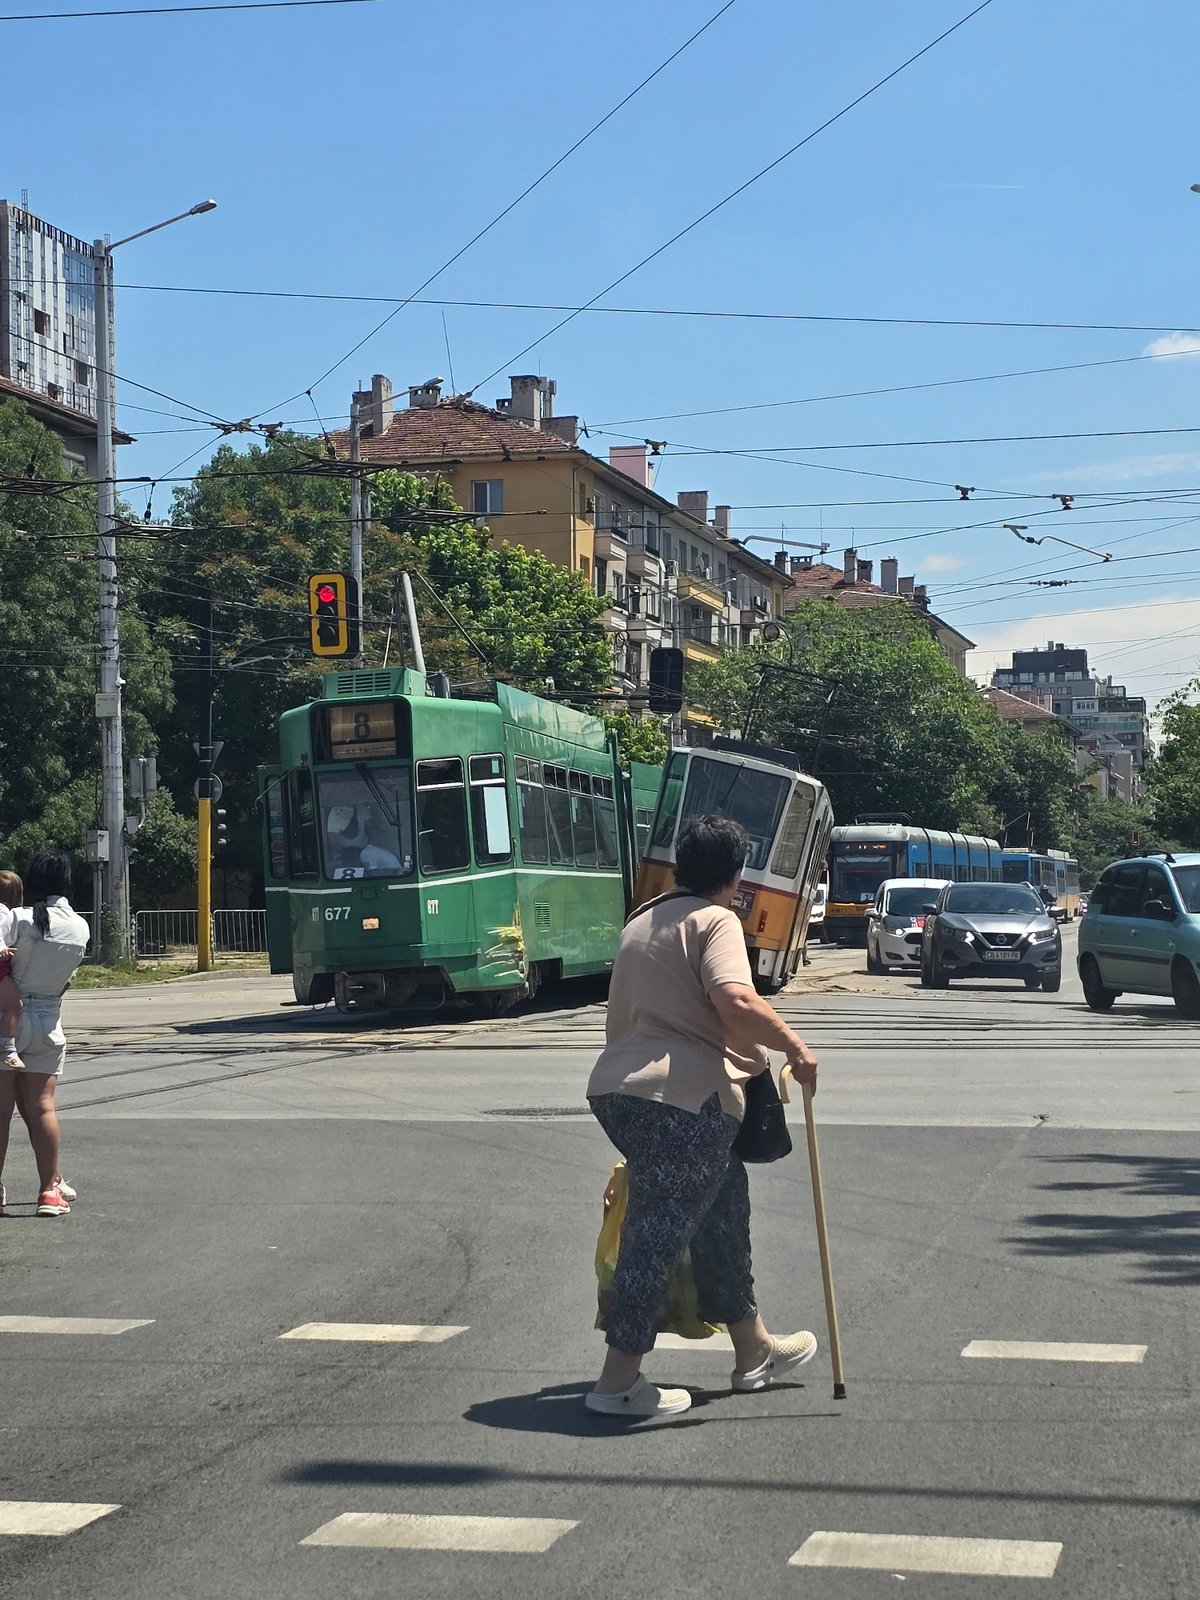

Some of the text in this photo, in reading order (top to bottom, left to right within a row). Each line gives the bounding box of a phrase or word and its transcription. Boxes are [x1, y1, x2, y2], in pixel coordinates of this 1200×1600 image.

[354, 711, 371, 740] 8
[341, 868, 356, 880] 8
[324, 906, 351, 921] 677
[427, 899, 439, 914] 677
